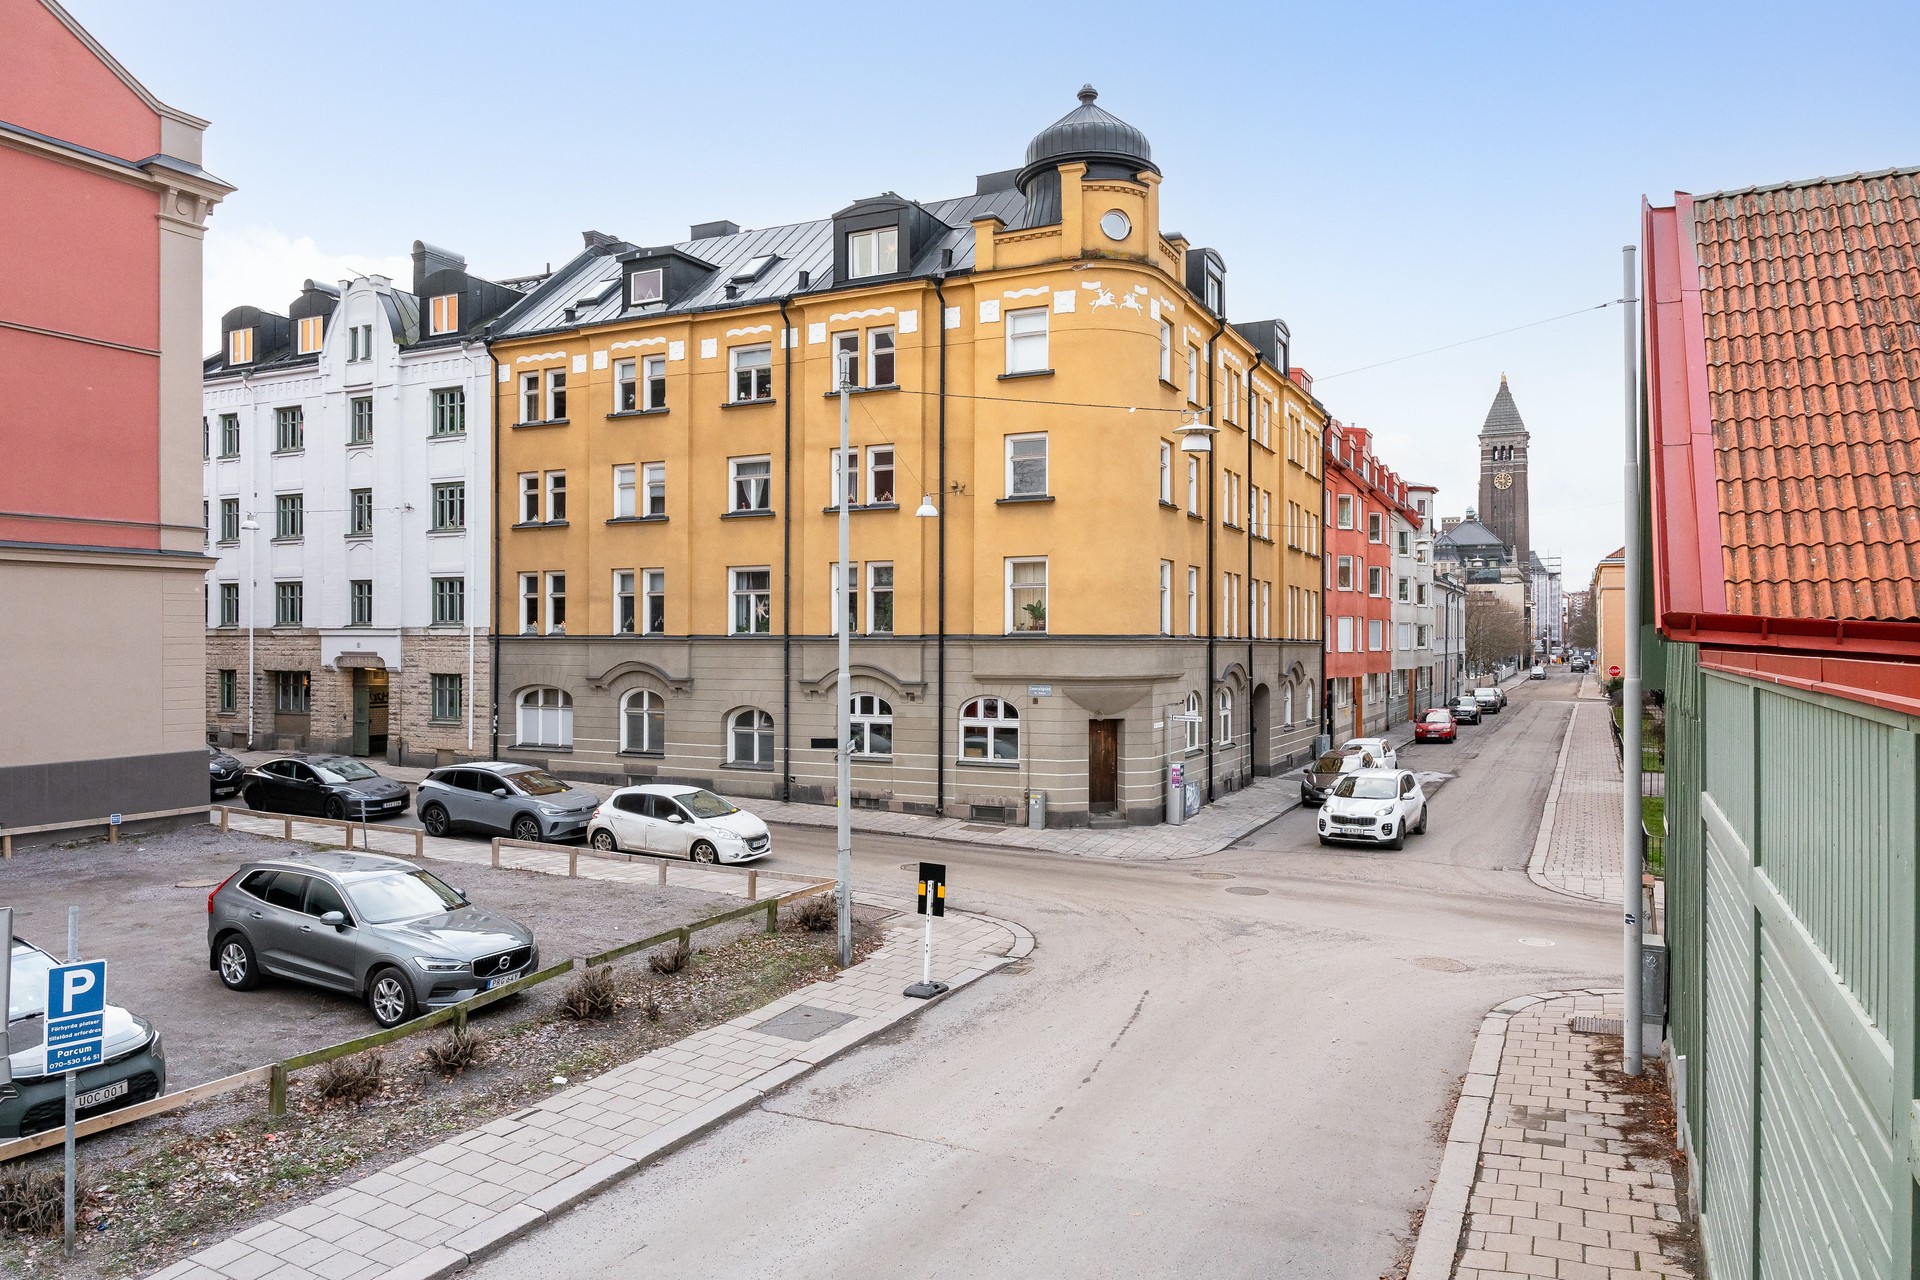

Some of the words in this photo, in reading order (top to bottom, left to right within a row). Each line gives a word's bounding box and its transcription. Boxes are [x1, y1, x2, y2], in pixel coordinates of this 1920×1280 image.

[492, 978, 505, 986] PRG
[62, 968, 96, 1013] P
[51, 1023, 78, 1032] Förhyrda
[79, 1019, 100, 1028] platser
[74, 1028, 102, 1037] erfordras
[57, 1046, 92, 1058] Parcum
[49, 1058, 81, 1069] 070-530
[79, 1092, 101, 1106] UOC
[103, 1084, 124, 1099] 001
